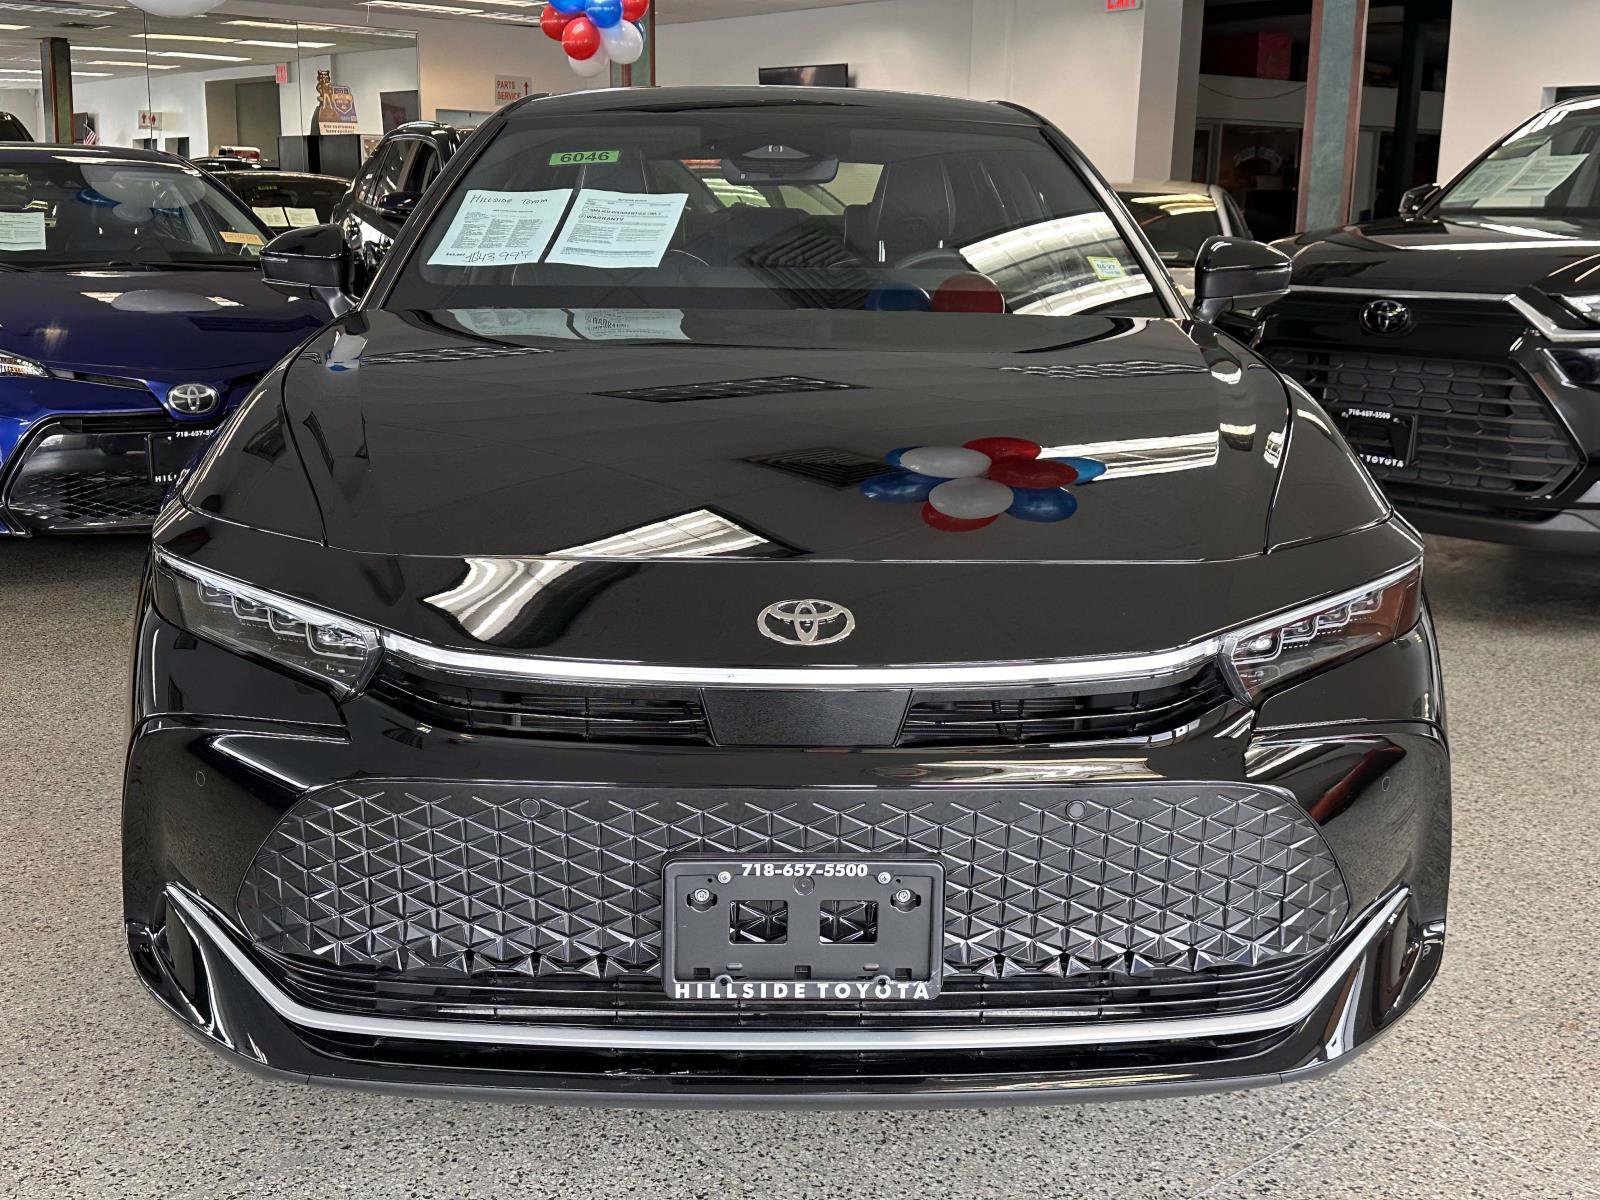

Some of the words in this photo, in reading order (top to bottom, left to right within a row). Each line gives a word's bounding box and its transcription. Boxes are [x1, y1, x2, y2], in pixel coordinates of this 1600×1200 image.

[560, 151, 609, 163] 6046
[1365, 454, 1404, 468] TOYOTA
[741, 863, 869, 877] 718-657-5500
[674, 983, 806, 999] HILLSIDE
[817, 983, 930, 999] TOYOTA
